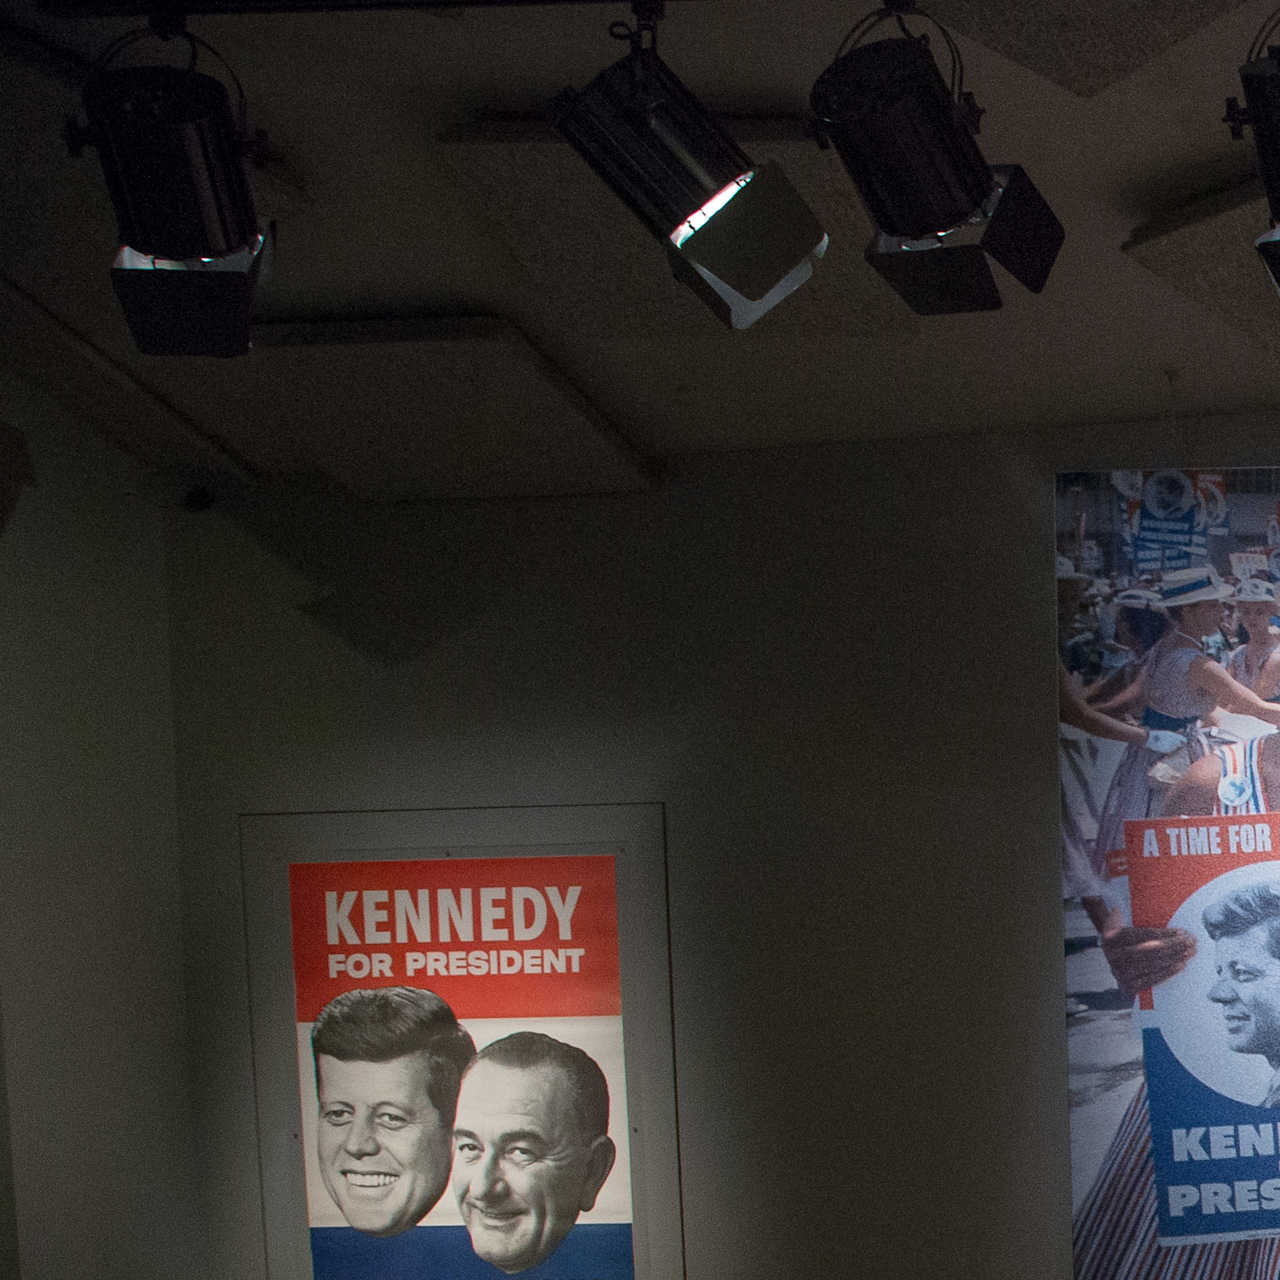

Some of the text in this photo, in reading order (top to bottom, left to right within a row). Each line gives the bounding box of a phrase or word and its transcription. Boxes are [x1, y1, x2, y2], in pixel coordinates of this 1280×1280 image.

[1143, 832, 1160, 857] A
[1166, 826, 1222, 856] TIME
[1228, 822, 1272, 854] FOR
[324, 886, 583, 945] KENNEDY
[328, 947, 585, 979] FOR PRESIDENT
